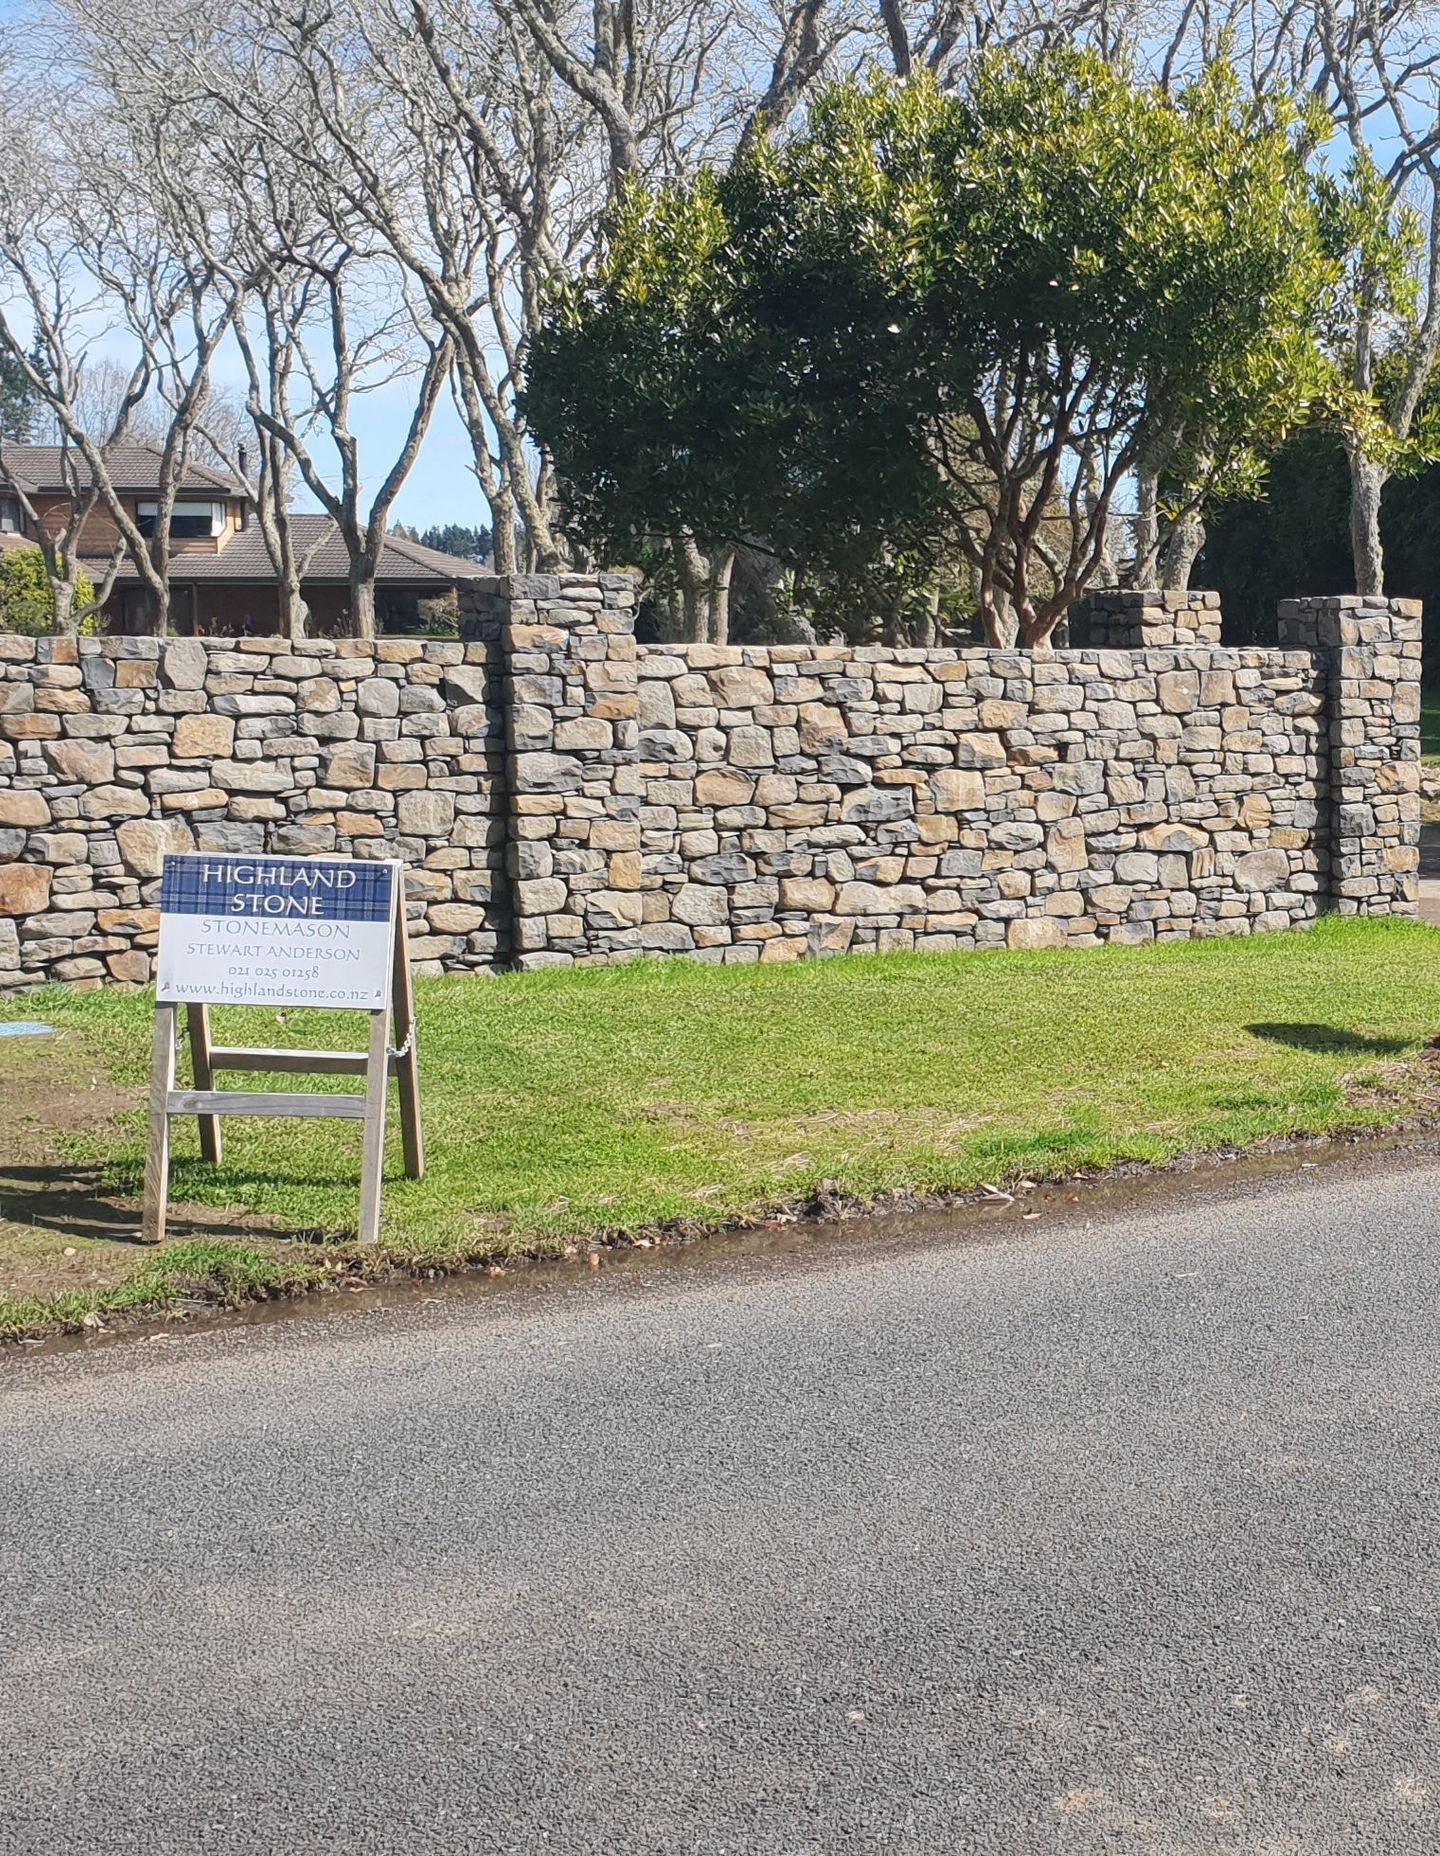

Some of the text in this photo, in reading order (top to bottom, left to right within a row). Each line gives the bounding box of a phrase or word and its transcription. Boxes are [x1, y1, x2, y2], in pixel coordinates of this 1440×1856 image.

[203, 864, 356, 889] HIGHLAND
[231, 893, 325, 915] STONE
[201, 919, 350, 940] STONEMASON
[186, 942, 361, 961] STEWART ANDERSON
[228, 965, 319, 979] 021 025 01258
[176, 980, 369, 1000] www.highlandstone.co.nz
